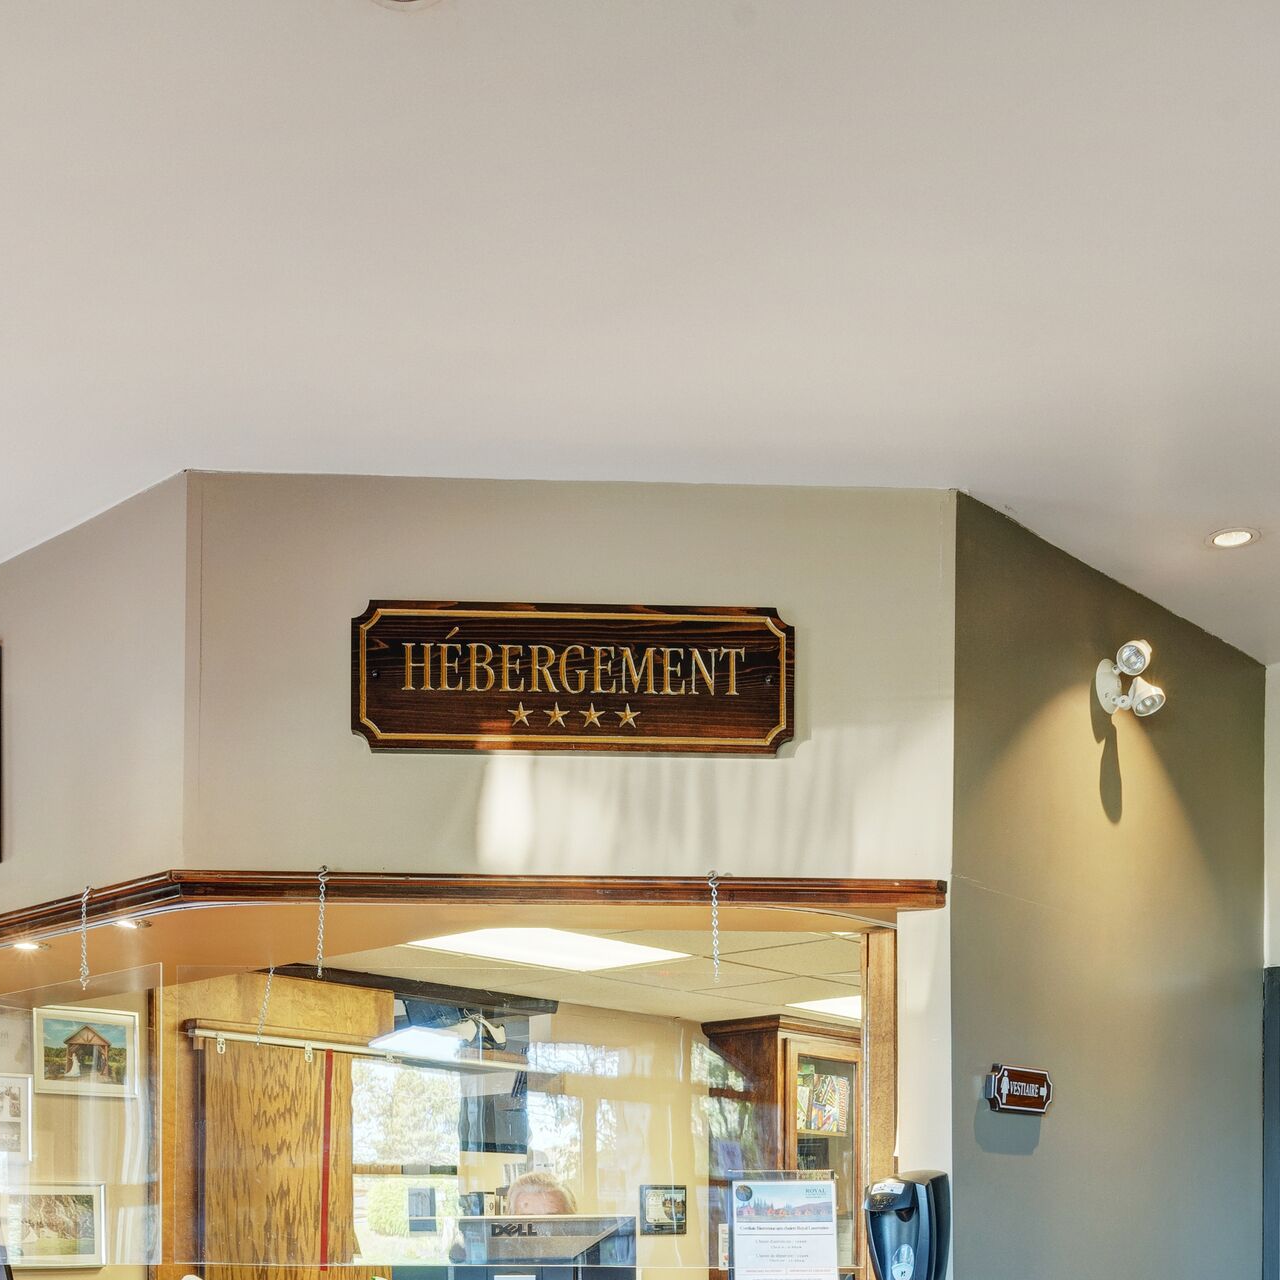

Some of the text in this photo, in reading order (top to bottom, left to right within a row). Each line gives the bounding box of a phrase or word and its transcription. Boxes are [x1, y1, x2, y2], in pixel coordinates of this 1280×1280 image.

[401, 627, 746, 696] HÉBERGEMENT
[1010, 1081, 1039, 1097] VESTIAIRE
[491, 1223, 537, 1237] DELL
